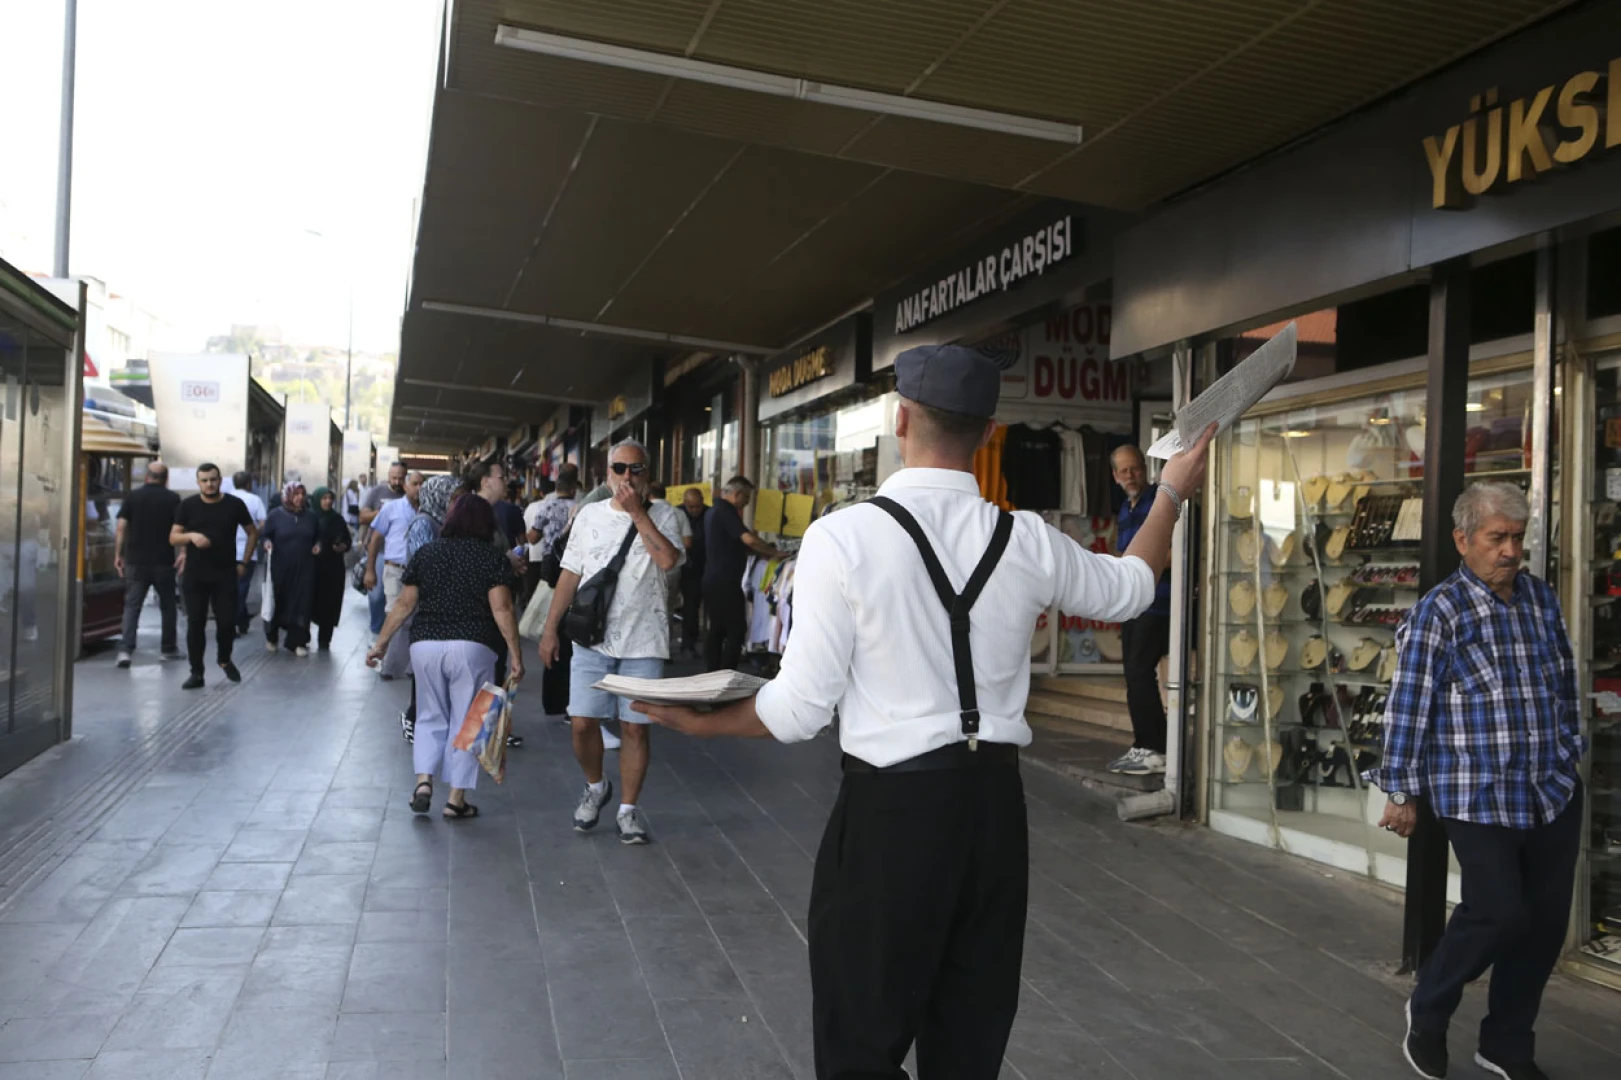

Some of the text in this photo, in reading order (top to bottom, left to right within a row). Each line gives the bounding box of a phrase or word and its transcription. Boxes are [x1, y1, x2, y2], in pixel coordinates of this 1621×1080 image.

[895, 215, 1072, 334] ANAFARTALAR ÇARŞISI
[1044, 305, 1112, 345] MOD
[1033, 346, 1127, 402] DÜĞM
